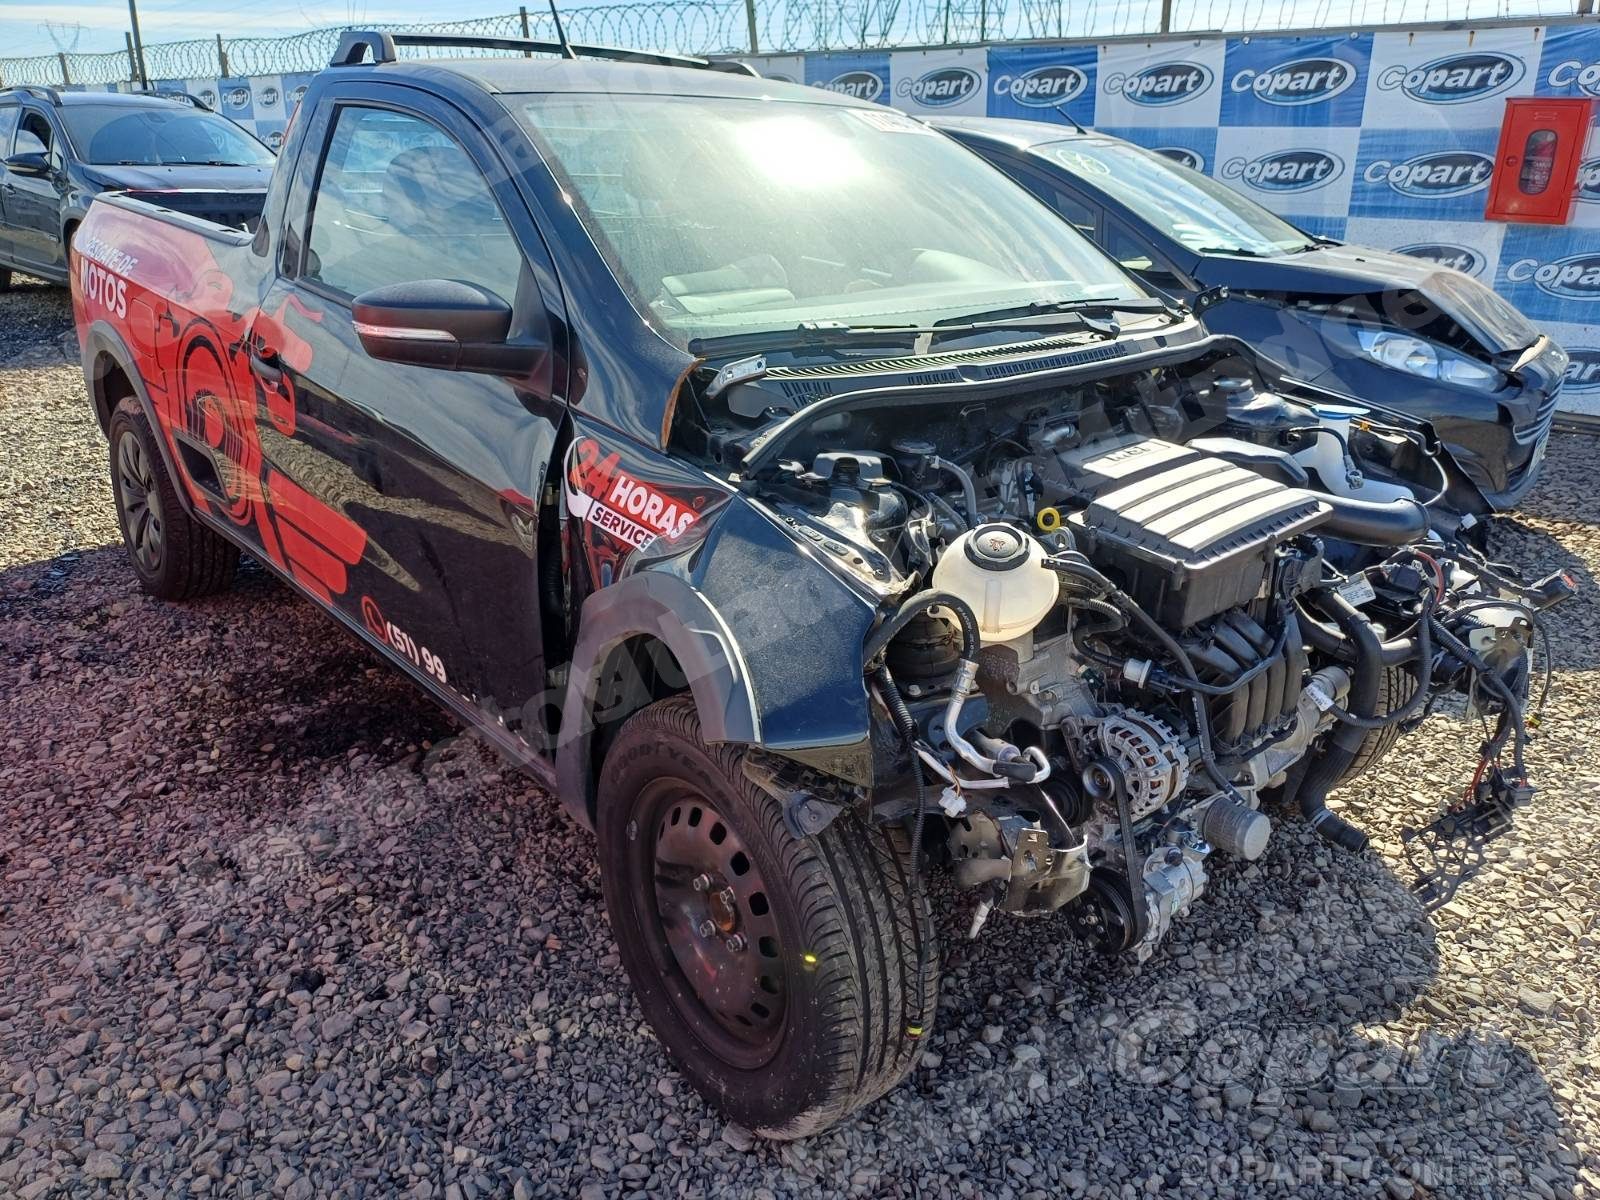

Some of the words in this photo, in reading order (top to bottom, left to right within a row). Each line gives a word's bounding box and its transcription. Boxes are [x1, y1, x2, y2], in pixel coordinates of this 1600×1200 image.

[896, 75, 971, 98] Copart
[993, 73, 1076, 98] Copart
[1103, 71, 1199, 98] Copart
[1230, 65, 1340, 95] Copart
[1377, 59, 1507, 96] Copart
[1221, 154, 1330, 184] Copart
[1363, 158, 1493, 190] Copart
[80, 256, 128, 320] MOTOS
[1507, 258, 1600, 289] Copa
[569, 438, 622, 501] 24
[608, 475, 695, 540] HORAS
[592, 506, 654, 550] SERVICE
[386, 620, 420, 667] (51)
[421, 646, 447, 684] 99
